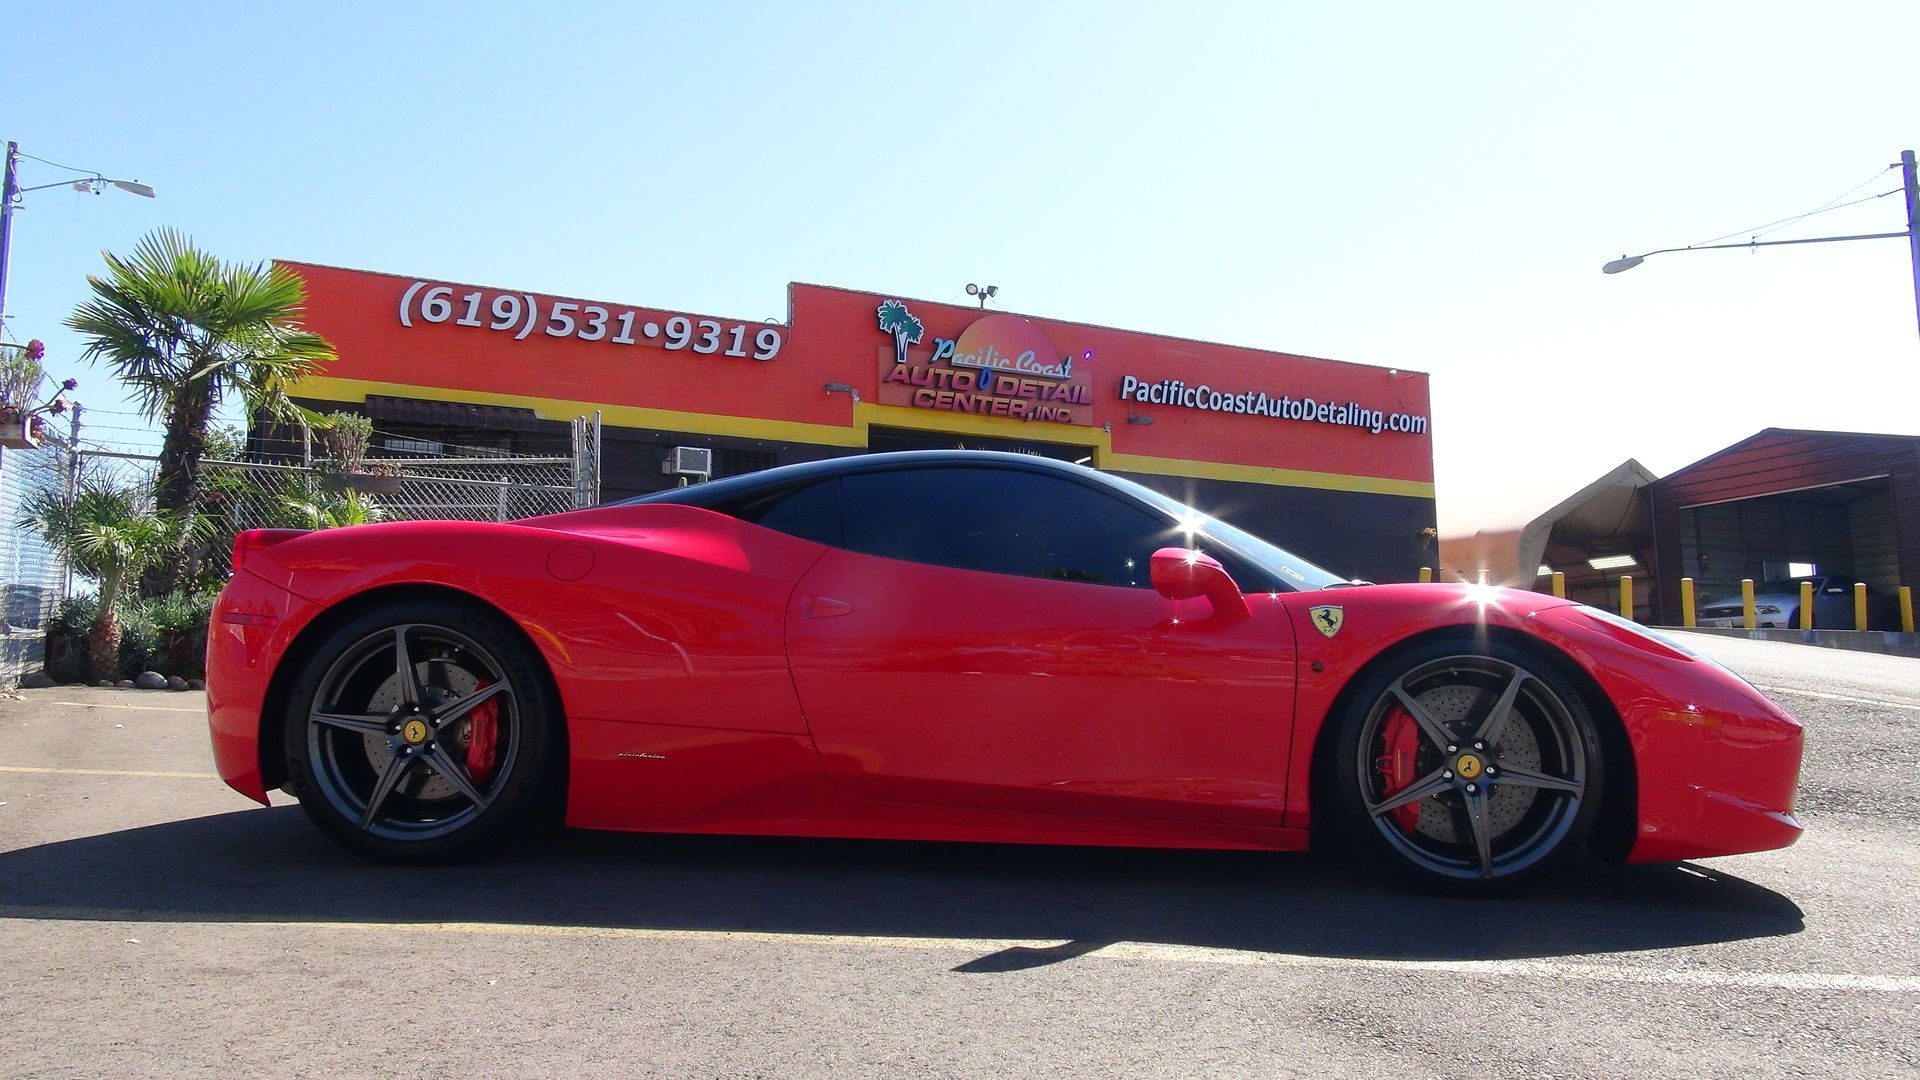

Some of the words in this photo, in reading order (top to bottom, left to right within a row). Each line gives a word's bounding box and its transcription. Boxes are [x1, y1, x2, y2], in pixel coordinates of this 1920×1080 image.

[886, 364, 976, 390] AUTO
[996, 376, 1091, 405] DETAIL
[932, 337, 1011, 389] Pacific
[1015, 350, 1073, 379] Coast
[1121, 375, 1427, 434] PacificCoastAutoDetaling.com
